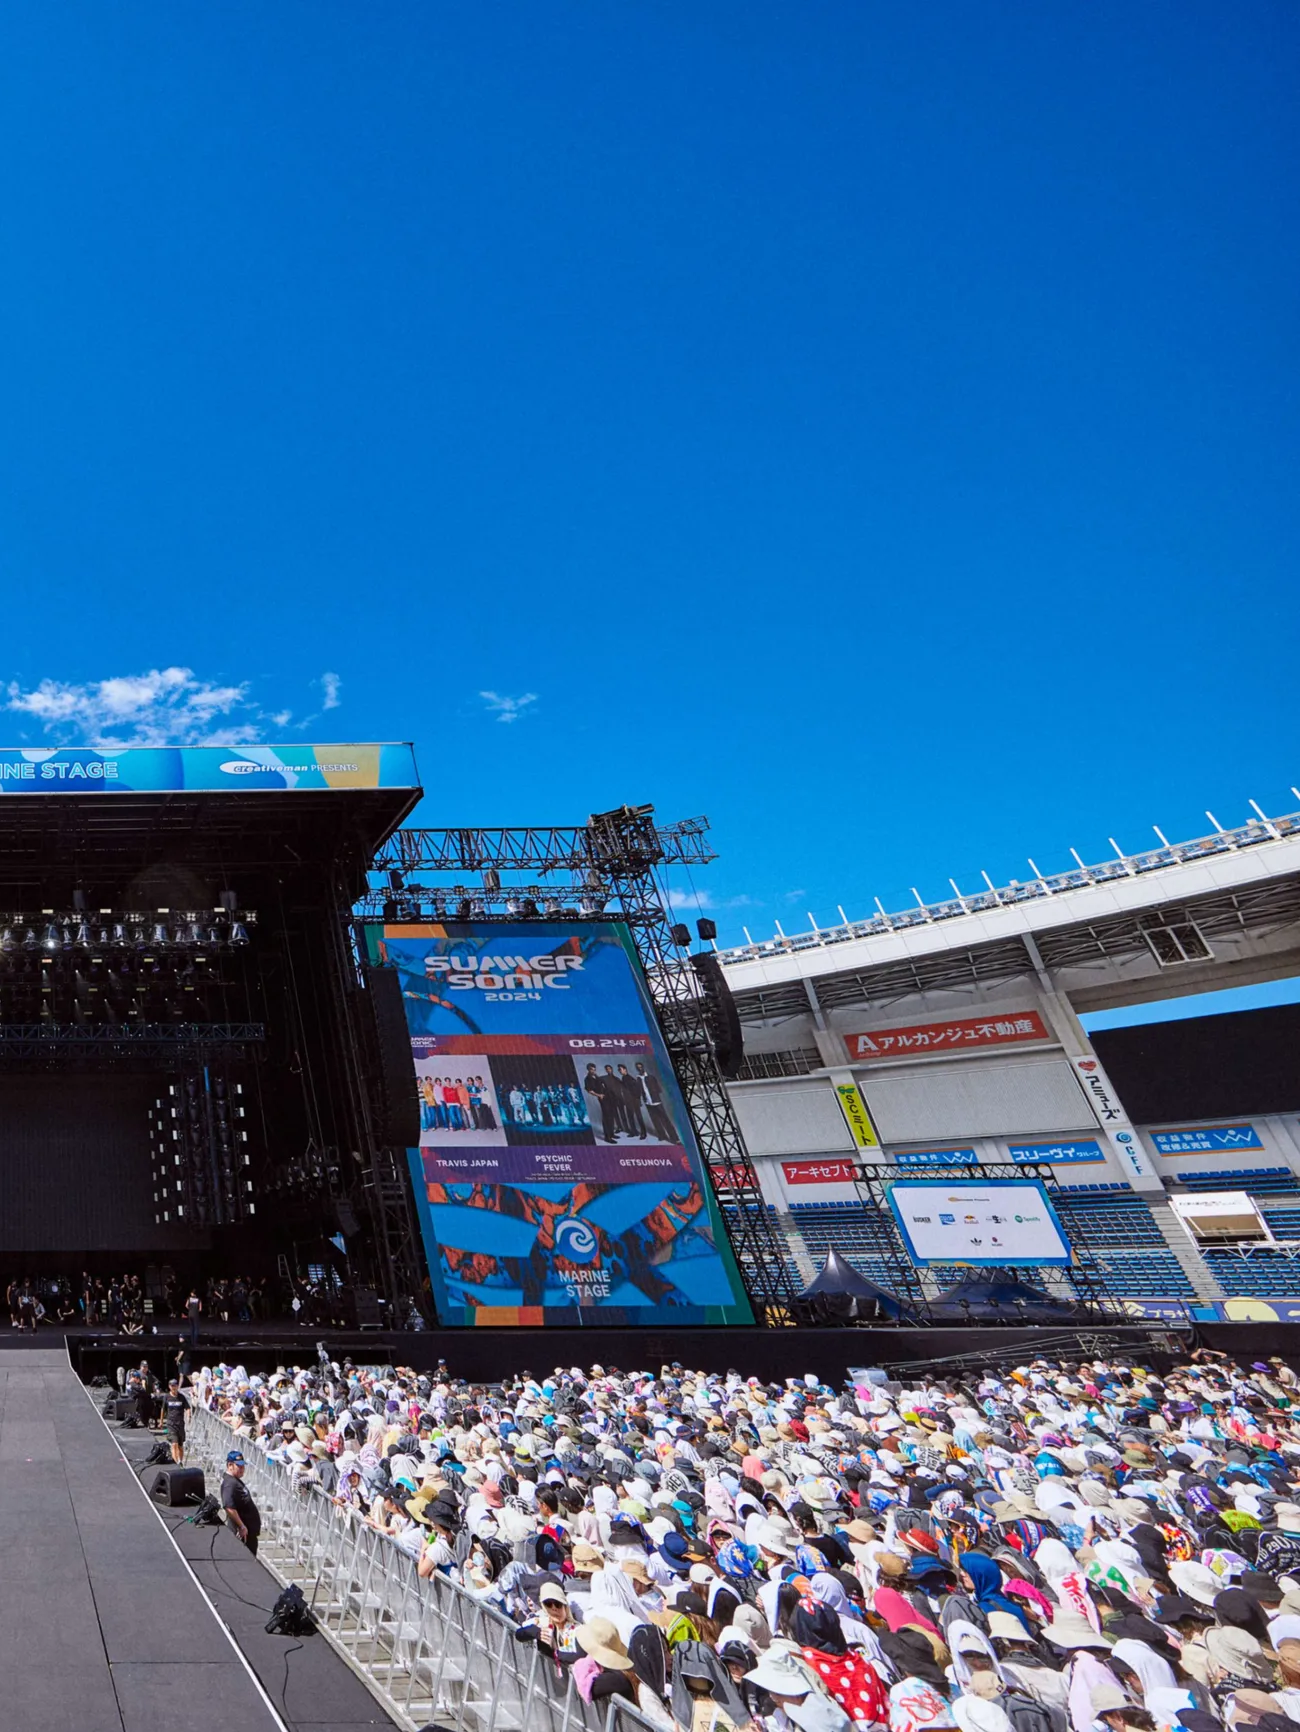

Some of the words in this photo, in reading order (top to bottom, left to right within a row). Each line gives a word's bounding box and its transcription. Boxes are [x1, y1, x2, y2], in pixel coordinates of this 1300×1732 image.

[41, 762, 119, 779] STAGE
[311, 763, 359, 773] PRESENTS
[424, 955, 586, 971] SUMMER
[448, 974, 572, 990] SONIC
[484, 992, 542, 1002] 2024
[878, 1019, 1036, 1050] アルカンジュ不動産
[568, 1039, 627, 1048] 08.24
[629, 1039, 646, 1047] SAT
[470, 1159, 499, 1167] JAPAN
[786, 1164, 851, 1179] アーキセプト
[558, 1269, 611, 1282] MARINE
[565, 1284, 611, 1298] STAGE
